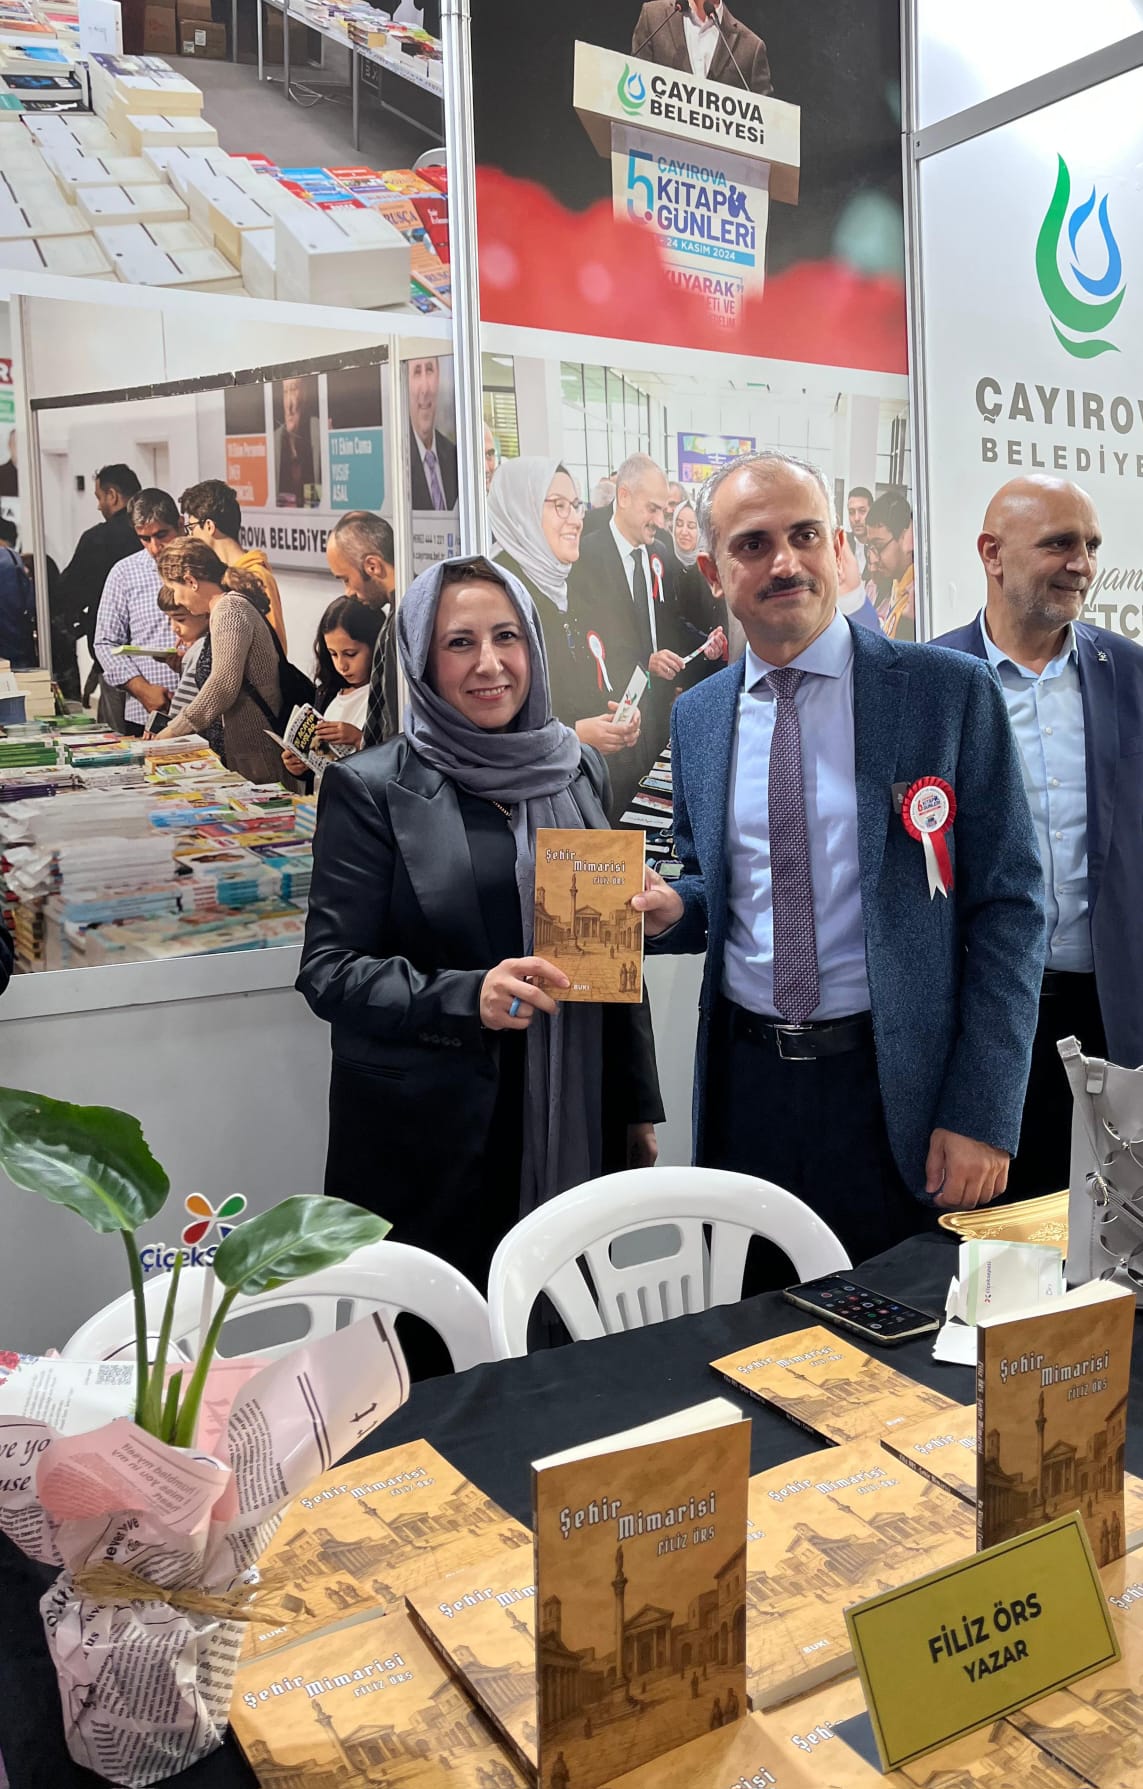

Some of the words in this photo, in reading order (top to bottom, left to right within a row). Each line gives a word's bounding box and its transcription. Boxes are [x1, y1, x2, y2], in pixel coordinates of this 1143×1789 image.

[650, 75, 764, 125] ÇAYIROVA
[657, 157, 728, 188] ÇAYIROVA
[657, 176, 727, 214] KİTAP
[657, 204, 756, 249] GÜNLERİ
[666, 239, 678, 249] 24
[713, 247, 737, 260] 2024
[546, 849, 576, 863] Şehir
[574, 860, 626, 873] Mimarisi
[737, 1357, 774, 1375] Şehir
[775, 1345, 834, 1369] Mimarisi
[1000, 1352, 1044, 1384] Şehir
[1040, 1351, 1110, 1387] Mimarisi
[1092, 1379, 1109, 1394] ÖRS
[913, 1435, 955, 1455] Şehir
[350, 1466, 427, 1499] Mimarisi
[767, 1478, 813, 1503] Şehir
[814, 1466, 887, 1495] Mimarisi
[300, 1484, 349, 1510] Şehir
[559, 1496, 623, 1539] Şehir
[617, 1491, 717, 1542] Mimarisi
[657, 1534, 688, 1557] FİLİZ
[693, 1525, 716, 1545] ÖRS
[439, 1587, 494, 1619] Şehir
[928, 1615, 990, 1664] FİLİZ
[993, 1592, 1043, 1633] ÖRS
[304, 1652, 406, 1700] Mimarisi
[962, 1639, 1030, 1683] YAZAR
[242, 1675, 304, 1709] Şehir
[354, 1681, 385, 1698] FİLİZ
[389, 1671, 414, 1687] ÖRS
